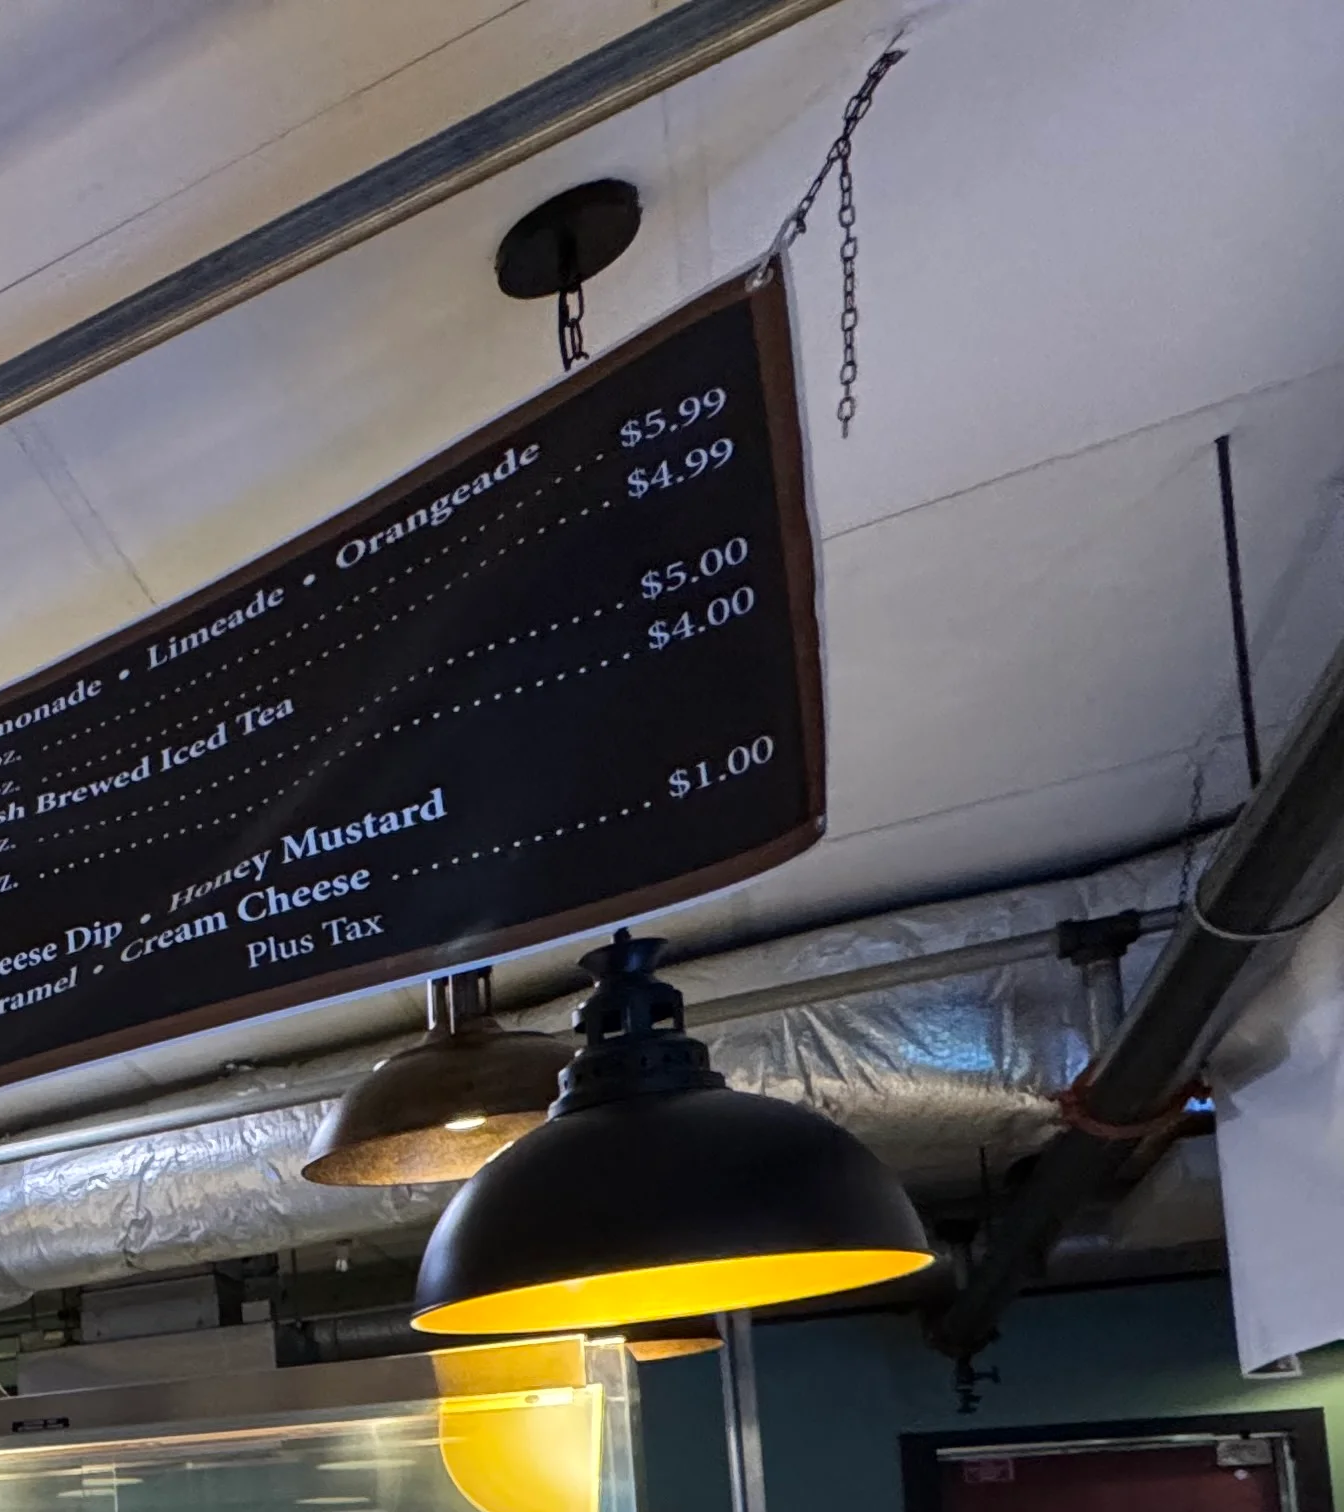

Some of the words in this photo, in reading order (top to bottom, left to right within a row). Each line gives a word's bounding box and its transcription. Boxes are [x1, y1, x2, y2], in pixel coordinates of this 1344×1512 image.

[620, 387, 727, 448] $5.99
[627, 437, 735, 499] $4.99
[146, 585, 285, 670] Limeade
[335, 442, 541, 569] Orangeade
[640, 537, 749, 600] $5.00
[648, 586, 755, 651] $4.00
[36, 756, 152, 815] Brewed
[160, 721, 229, 773] Iced
[235, 698, 295, 737] Tea
[64, 919, 123, 956] Dip
[167, 846, 272, 914] Honey
[280, 787, 448, 865] Mustard
[119, 908, 227, 964] Cream
[236, 867, 372, 923] Cheese
[668, 735, 774, 798] $1.00
[246, 930, 315, 969] Plus
[321, 911, 385, 949] Tax
